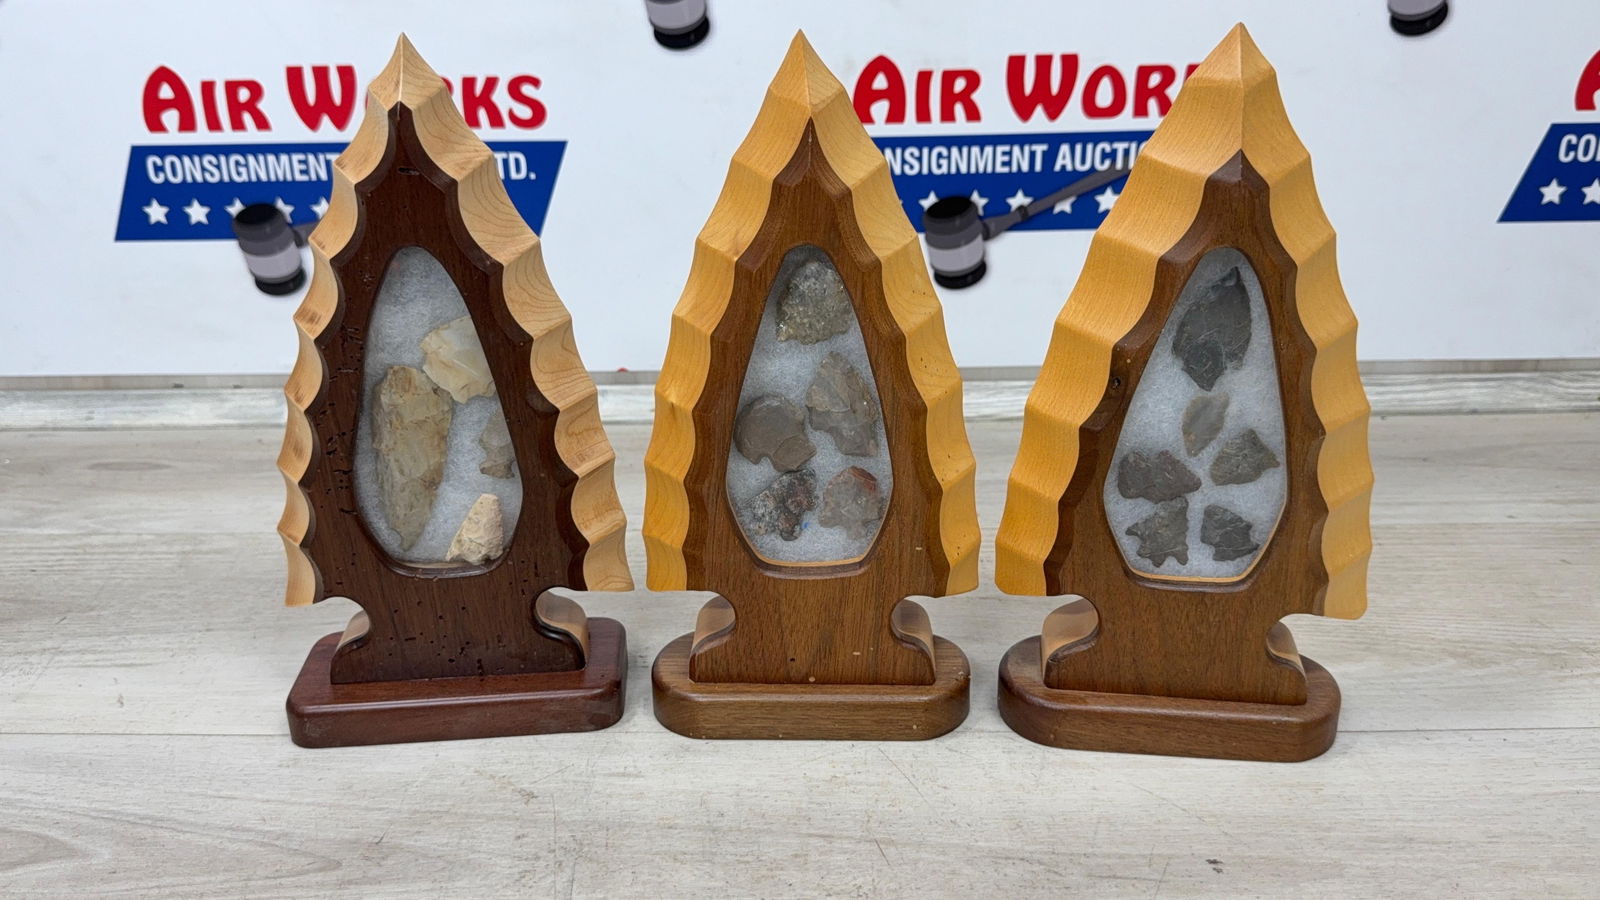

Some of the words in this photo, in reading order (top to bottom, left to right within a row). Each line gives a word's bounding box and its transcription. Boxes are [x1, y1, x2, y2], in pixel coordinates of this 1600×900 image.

[142, 65, 271, 133] AIR
[286, 66, 547, 130] WKS
[854, 55, 982, 125] AIR
[1006, 53, 1200, 122] WOR
[494, 151, 537, 180] TD.
[884, 143, 1048, 176] NSIGNMENT
[1054, 140, 1146, 172] AUCTI
[1558, 133, 1600, 163] CO
